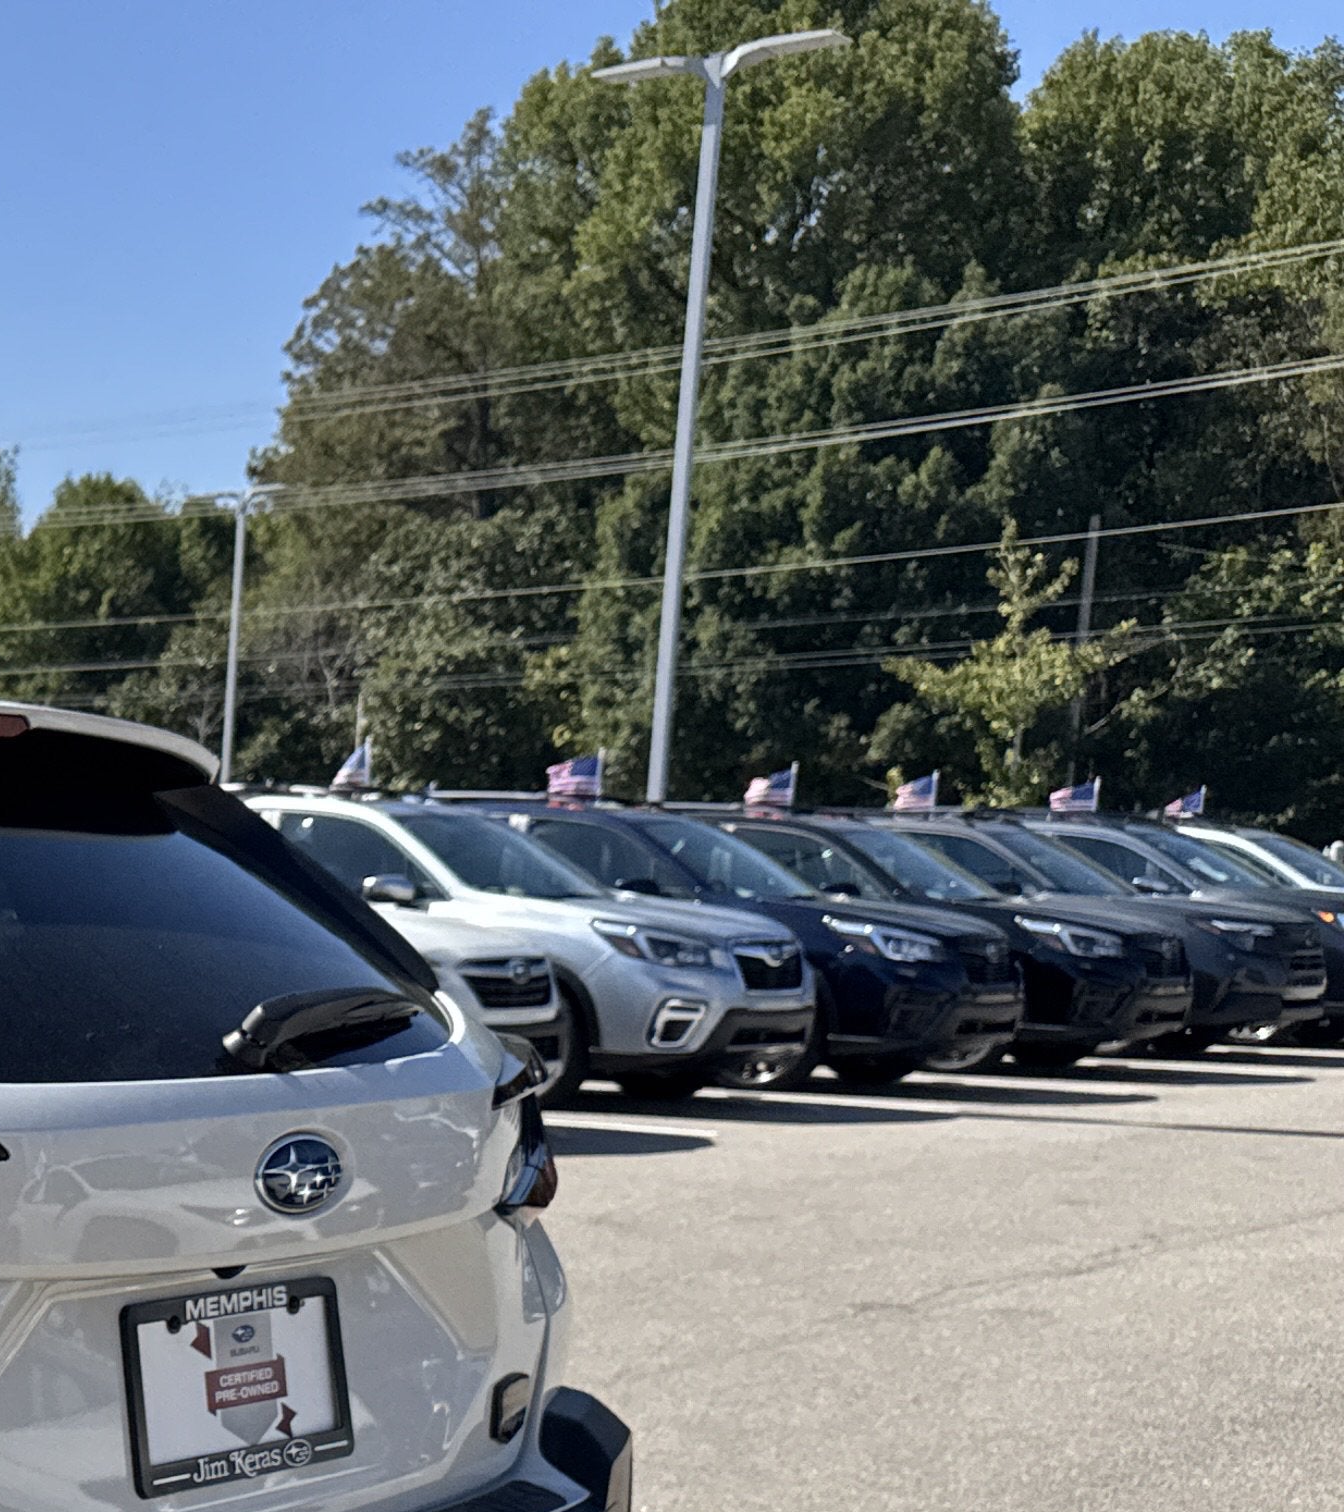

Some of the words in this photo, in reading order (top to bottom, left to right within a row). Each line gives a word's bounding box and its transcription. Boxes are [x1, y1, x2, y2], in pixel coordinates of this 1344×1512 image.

[185, 1285, 288, 1320] MEMPHIS
[215, 1380, 279, 1403] PRE-OWNED
[219, 1367, 273, 1387] CERTIFIED
[193, 1457, 229, 1483] Jim
[229, 1447, 283, 1478] Keras
